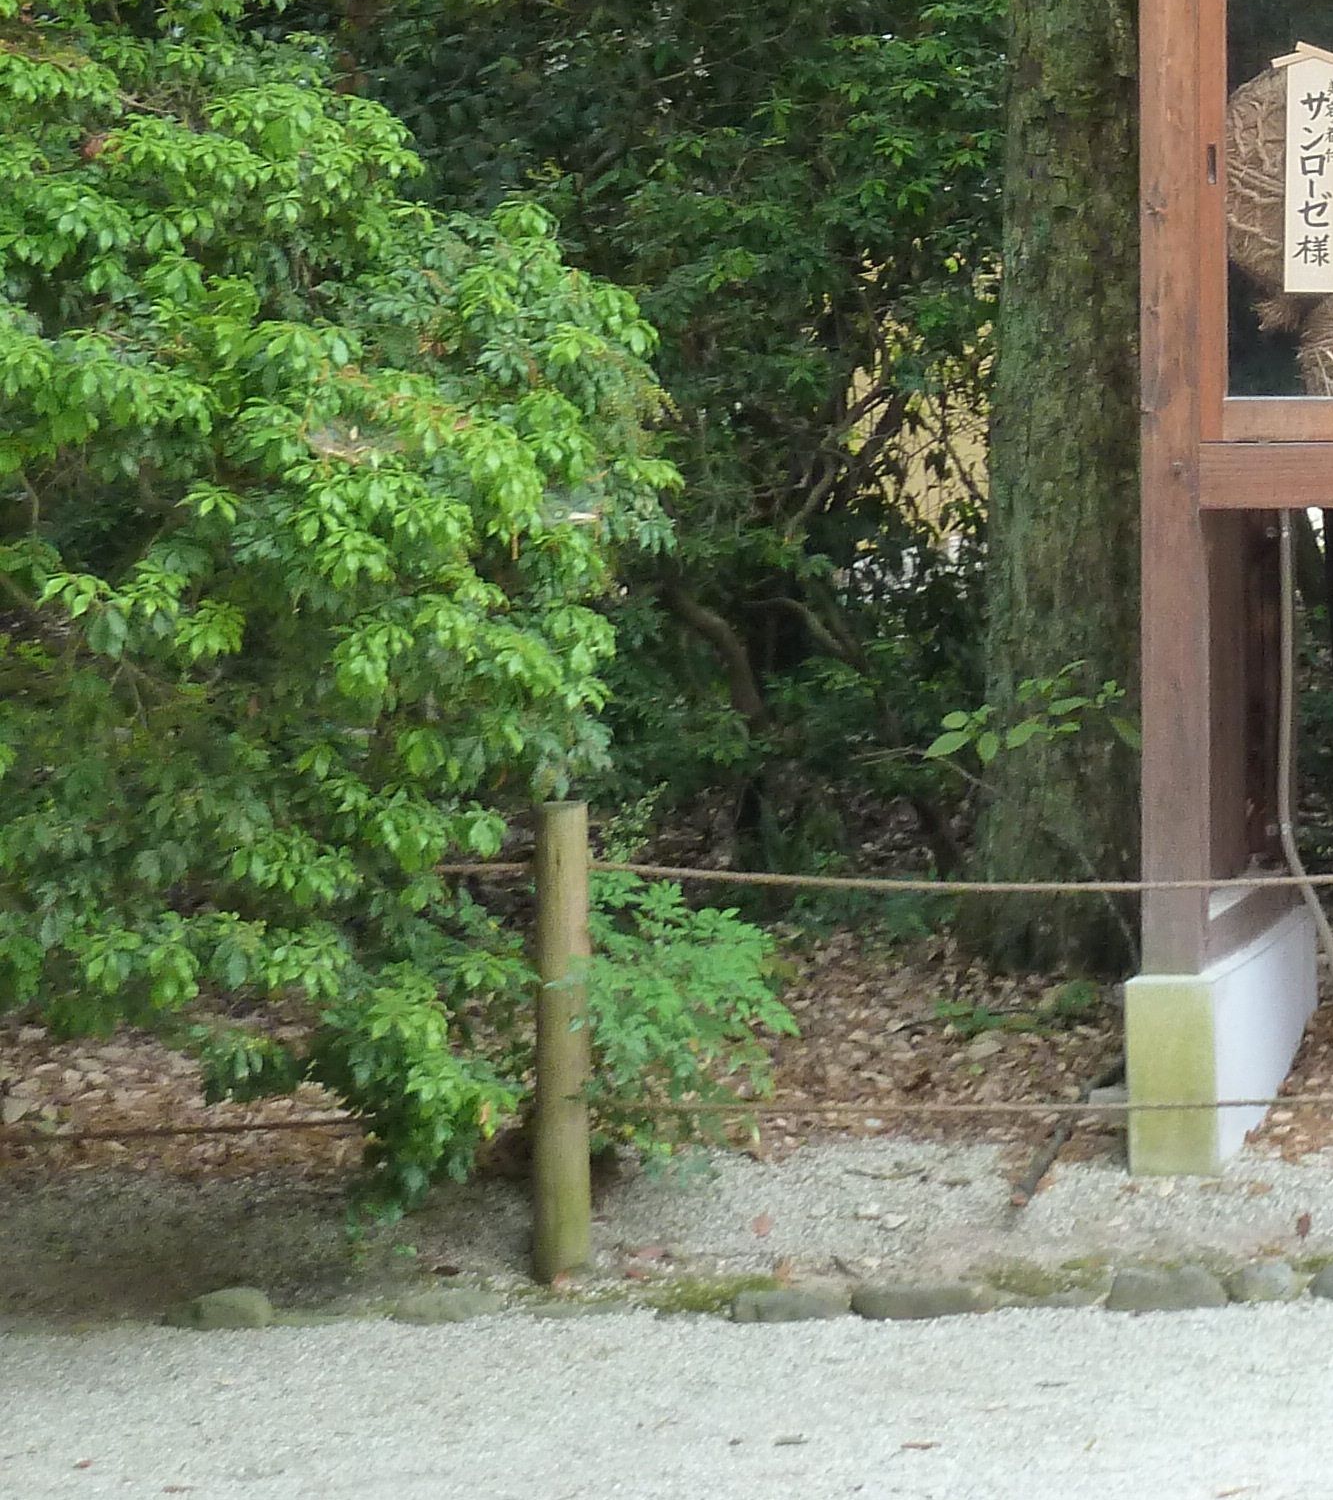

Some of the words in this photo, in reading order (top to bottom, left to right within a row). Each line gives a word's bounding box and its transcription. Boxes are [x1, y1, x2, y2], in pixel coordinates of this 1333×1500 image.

[1292, 90, 1333, 267] サンローゼ様
